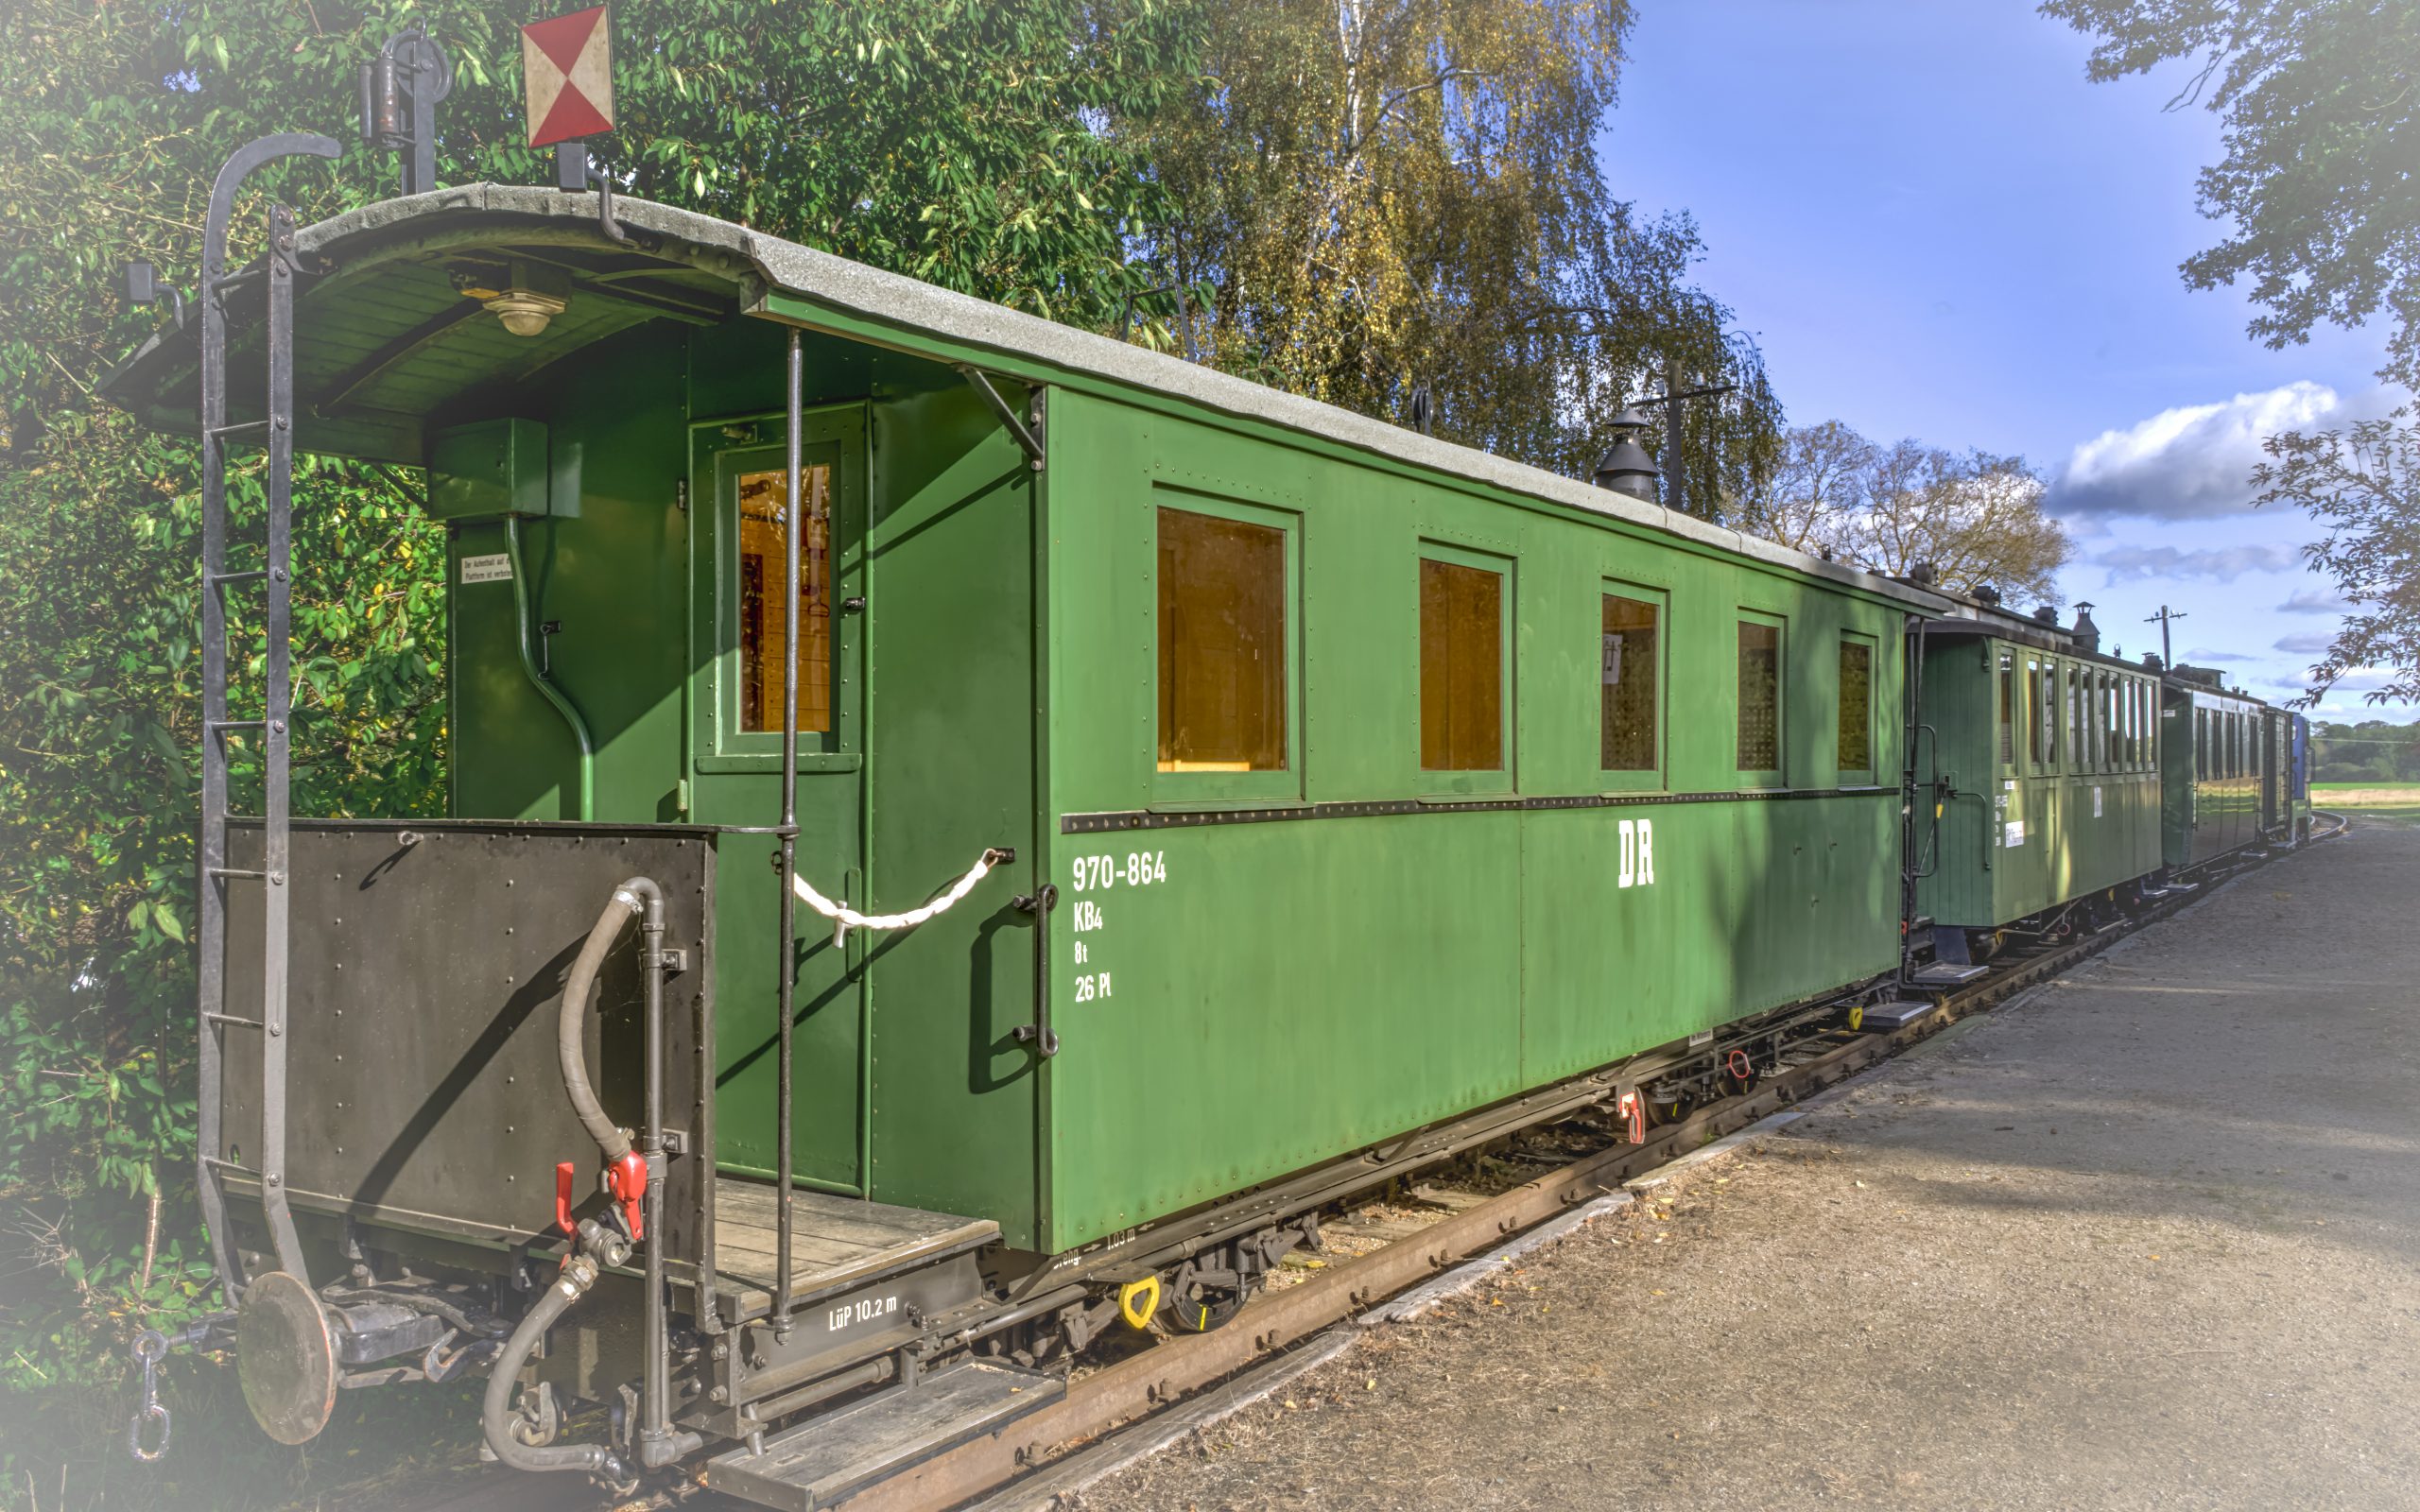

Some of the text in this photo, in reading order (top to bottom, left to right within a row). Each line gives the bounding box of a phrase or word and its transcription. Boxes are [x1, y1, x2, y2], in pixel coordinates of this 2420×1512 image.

[1618, 818, 1654, 888] DR
[1073, 850, 1167, 892] 970-864
[1074, 901, 1103, 932] KB4
[1075, 974, 1095, 1003] 26
[1107, 1230, 1126, 1250] 1.03
[1128, 1228, 1135, 1242] m
[829, 1296, 897, 1332] LüP 10.2 m
